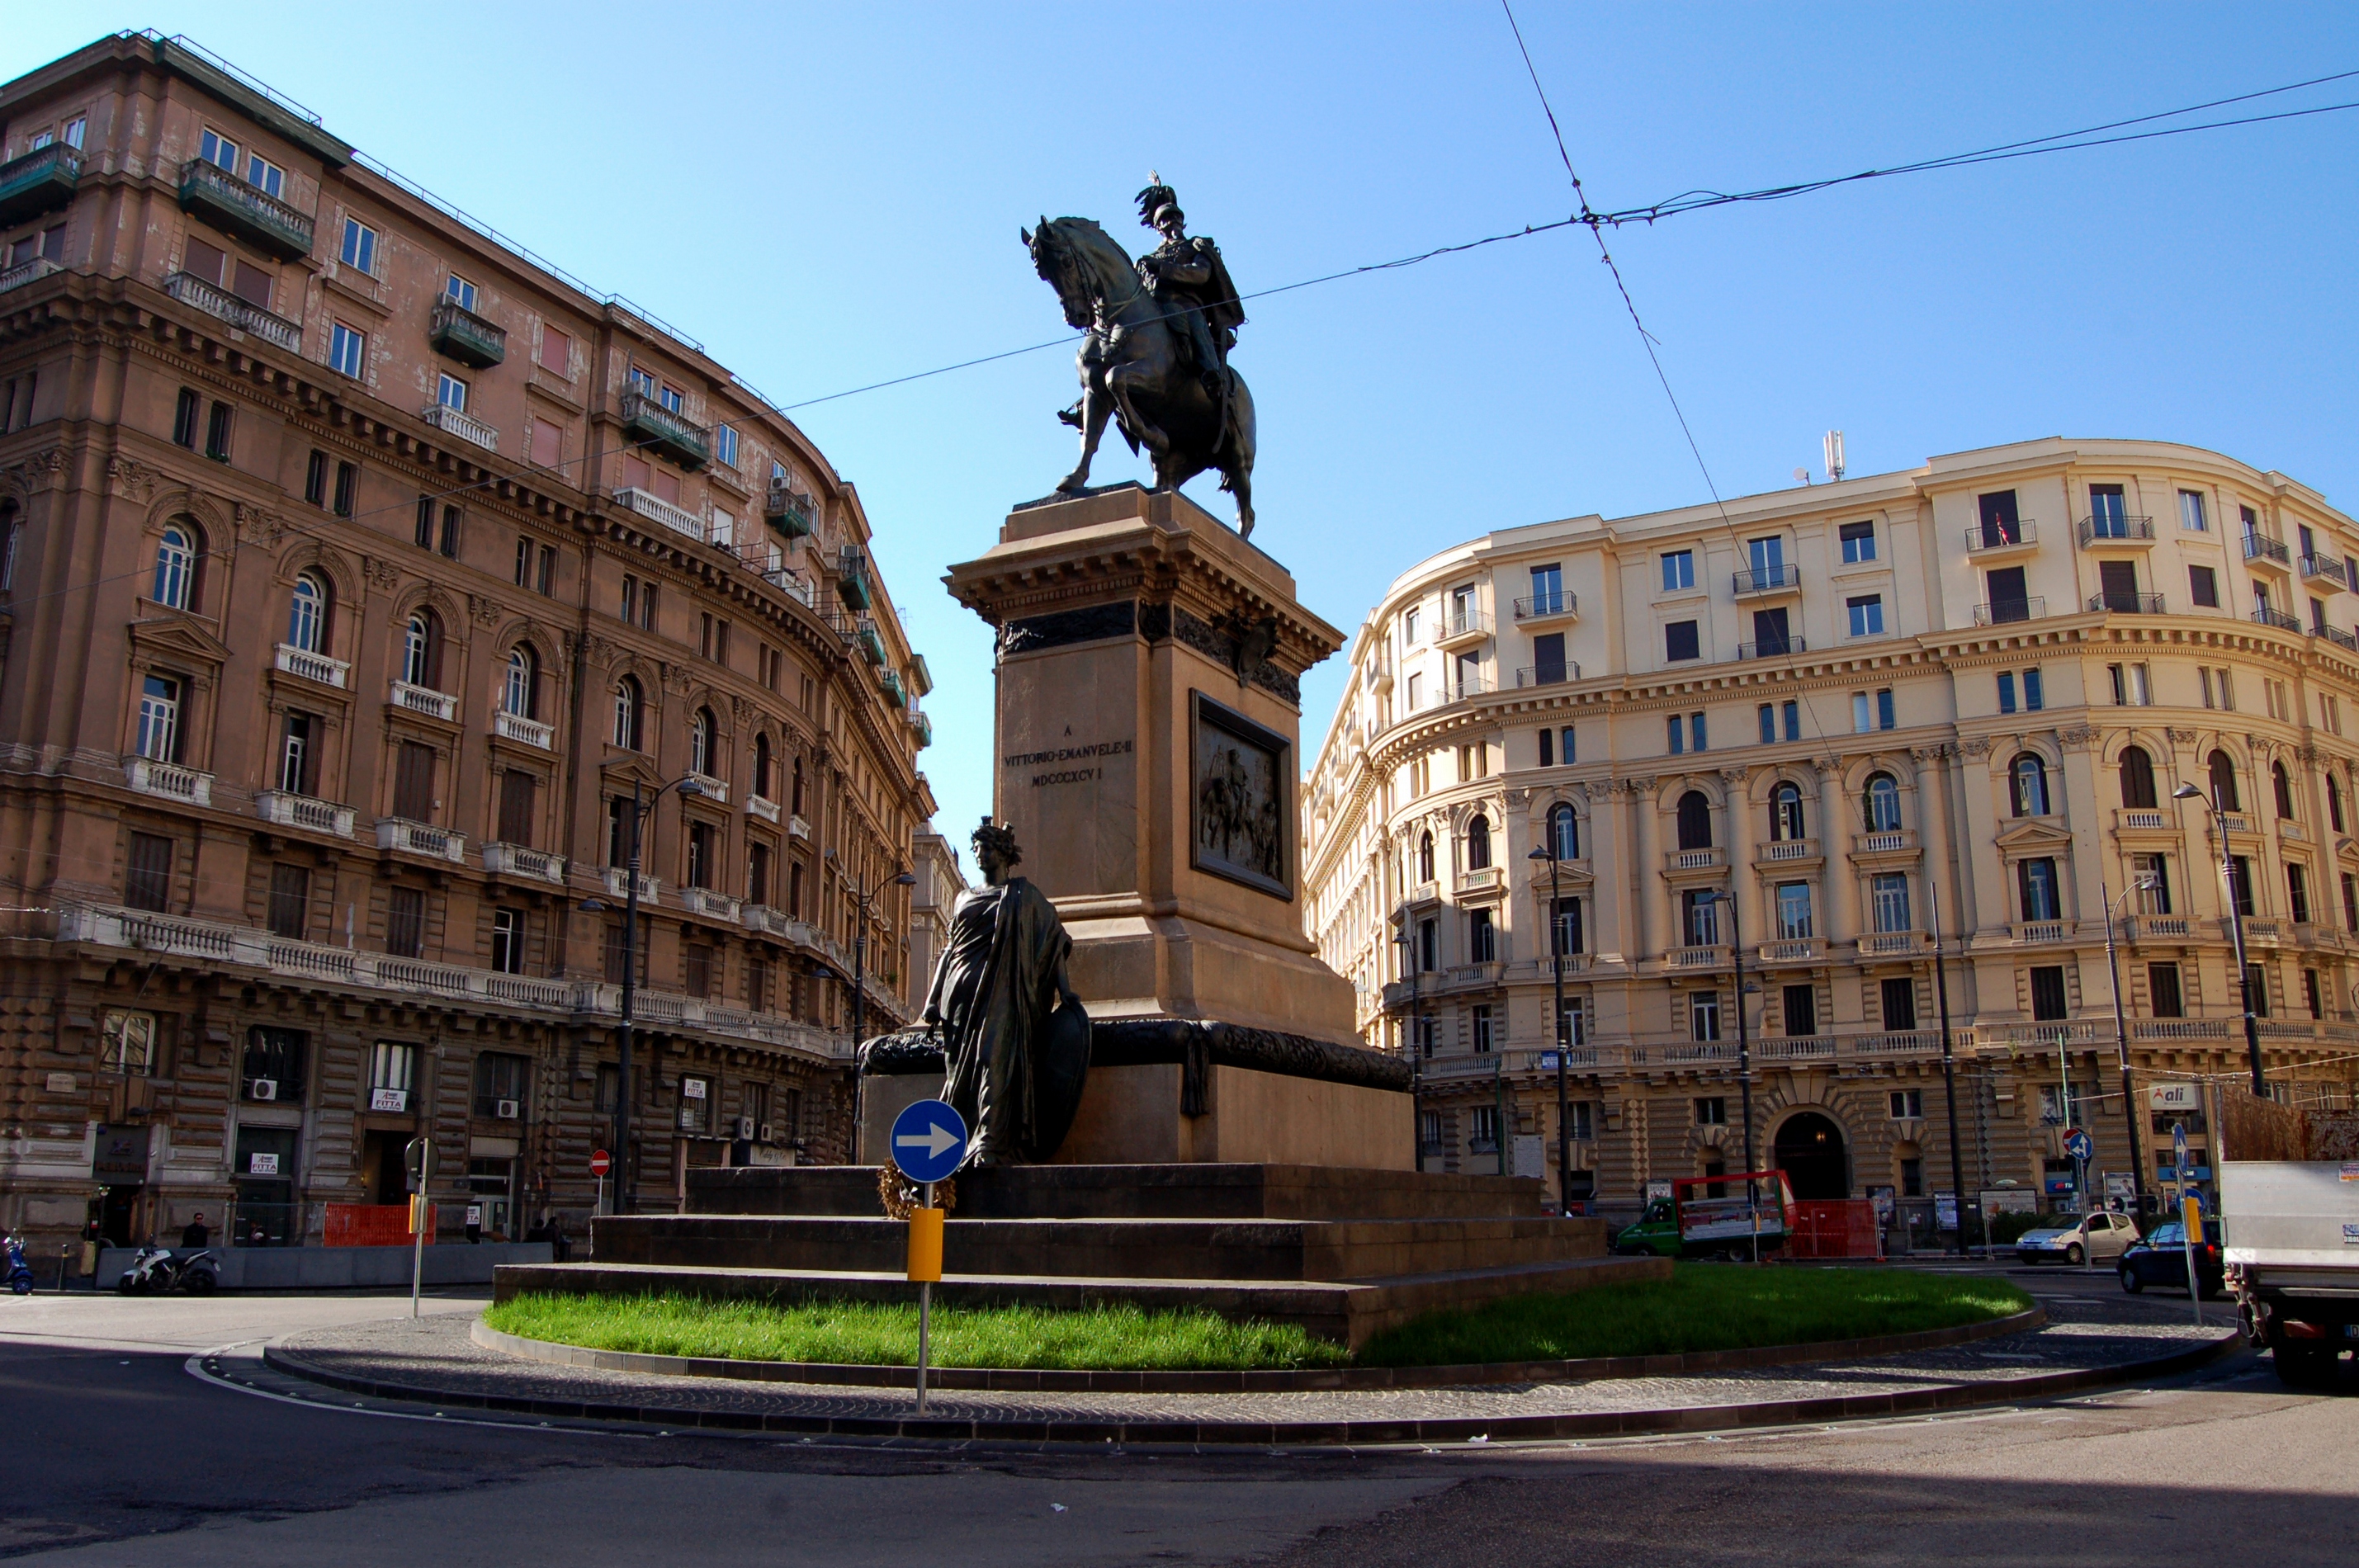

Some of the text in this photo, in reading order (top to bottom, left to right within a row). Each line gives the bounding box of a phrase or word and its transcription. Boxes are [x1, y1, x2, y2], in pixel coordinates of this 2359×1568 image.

[1063, 725, 1072, 737] A
[2164, 1087, 2184, 1102] ali
[376, 1099, 401, 1108] FITTA
